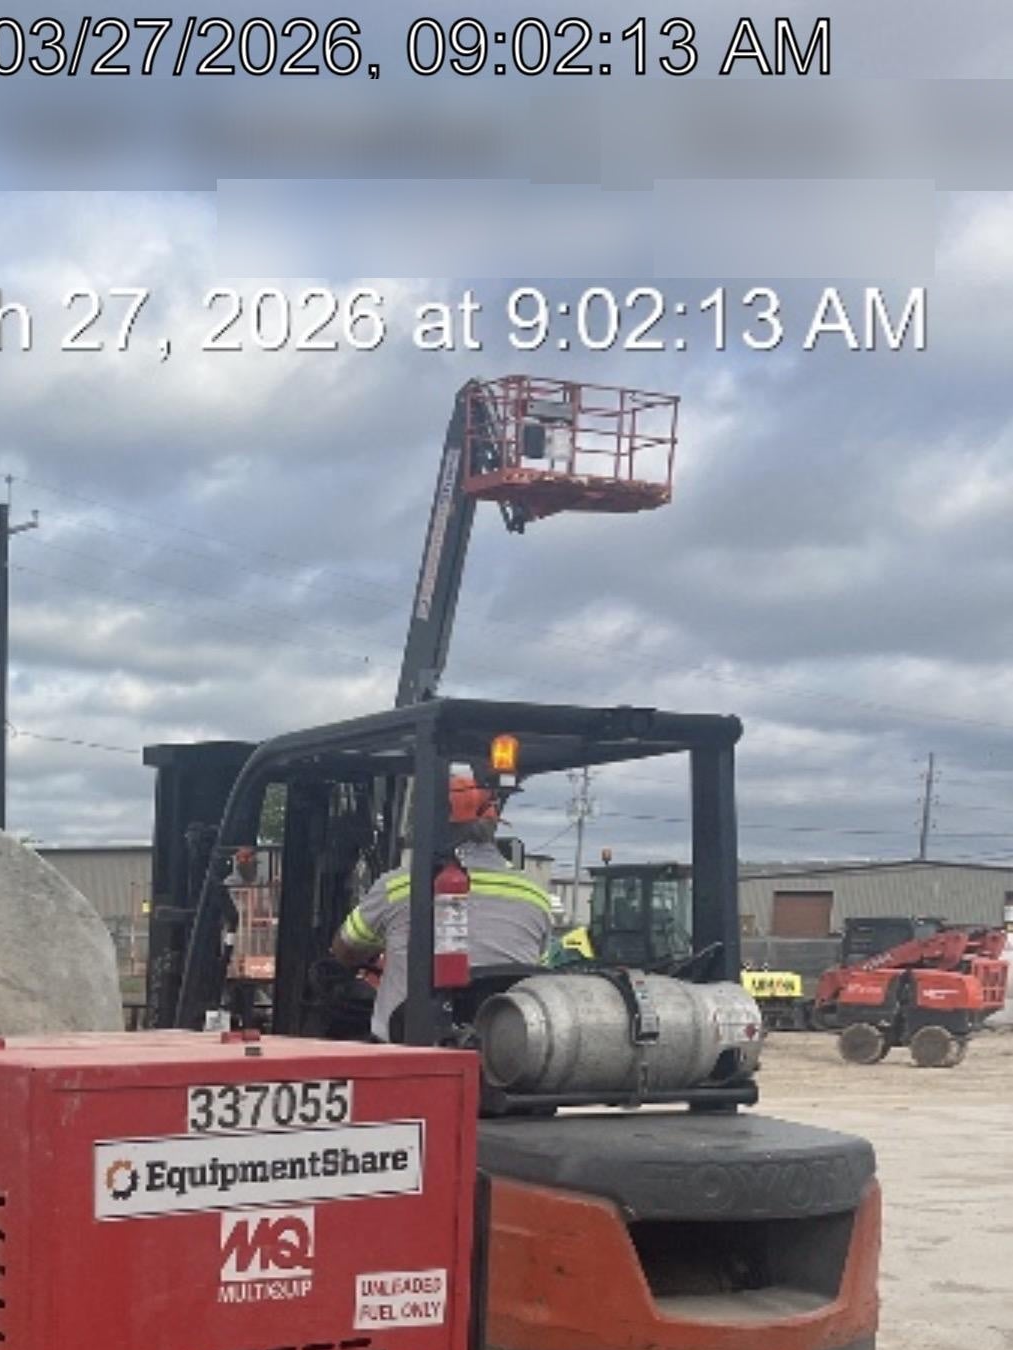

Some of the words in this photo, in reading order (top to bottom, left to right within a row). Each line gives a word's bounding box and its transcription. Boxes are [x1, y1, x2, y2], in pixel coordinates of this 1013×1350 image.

[190, 1081, 349, 1132] 337055
[146, 1148, 409, 1197] EquipmentShare
[220, 1213, 314, 1274] MQ
[217, 1279, 313, 1303] MULTIQUIP
[361, 1276, 443, 1297] UNLEADED
